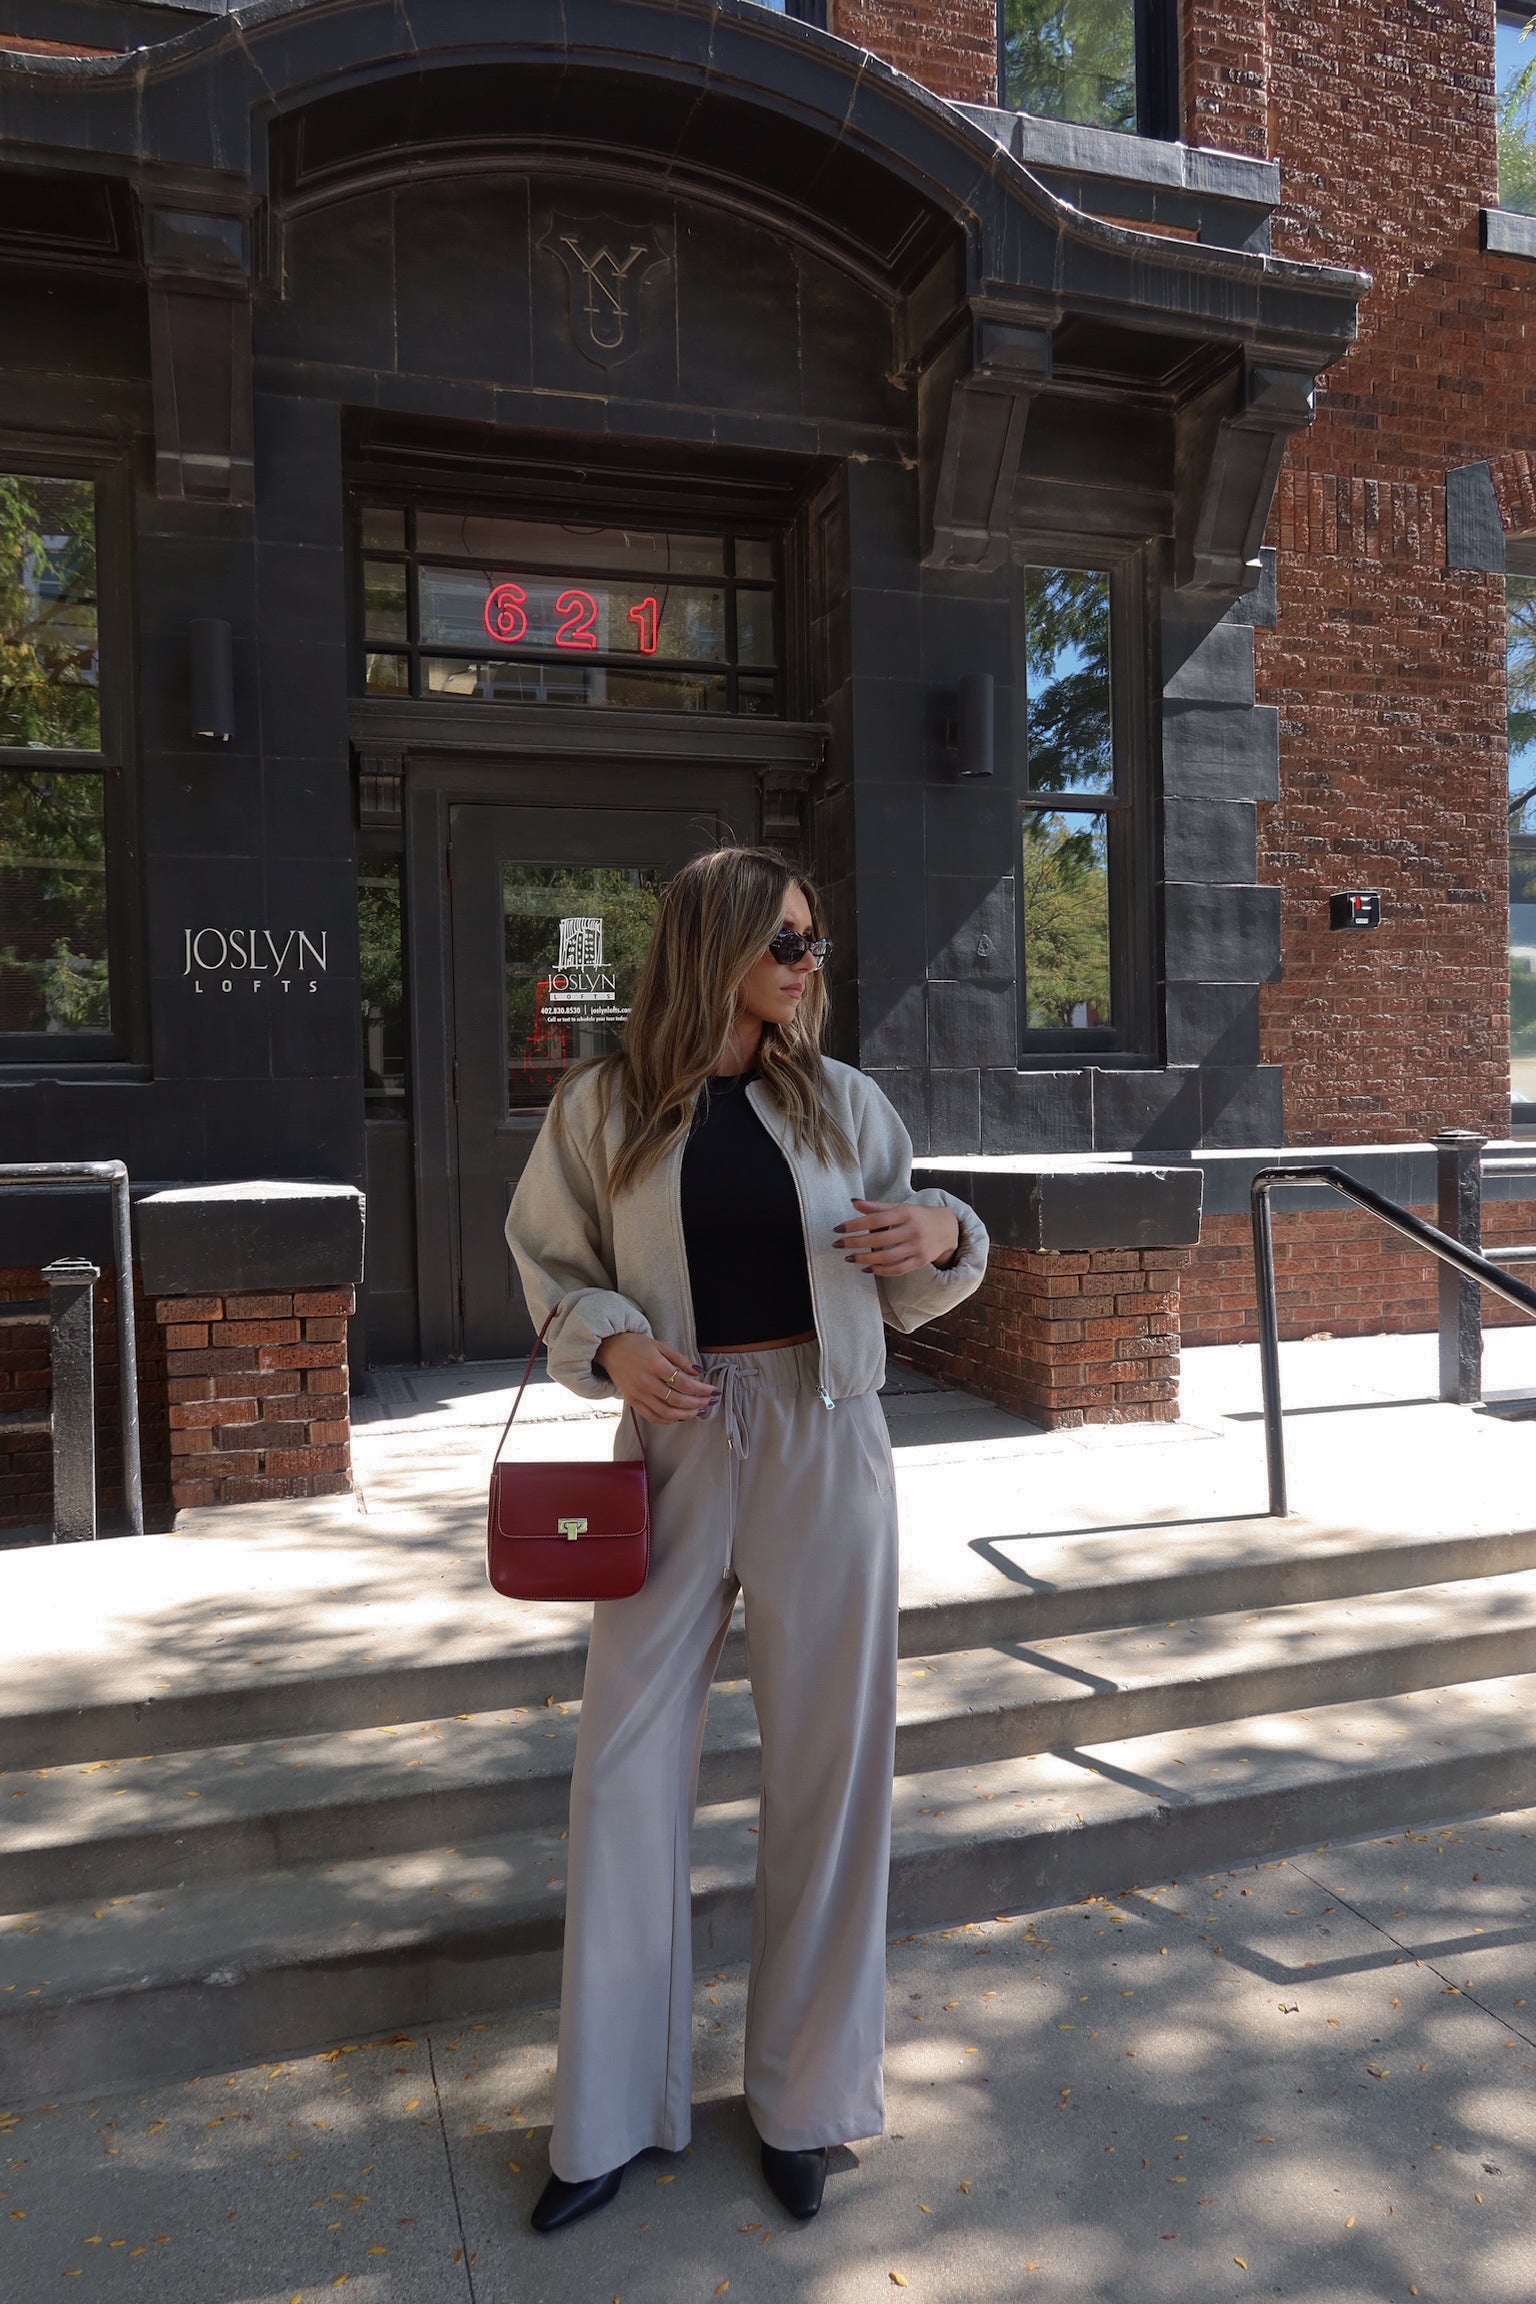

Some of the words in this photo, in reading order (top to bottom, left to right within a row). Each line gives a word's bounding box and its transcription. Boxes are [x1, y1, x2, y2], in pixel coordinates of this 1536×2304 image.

[484, 583, 658, 655] 621
[183, 928, 327, 977] JOSLYN
[195, 979, 318, 993] LOFTS
[548, 973, 616, 992] JOSLYN
[540, 1006, 581, 1014] 402.830.8530
